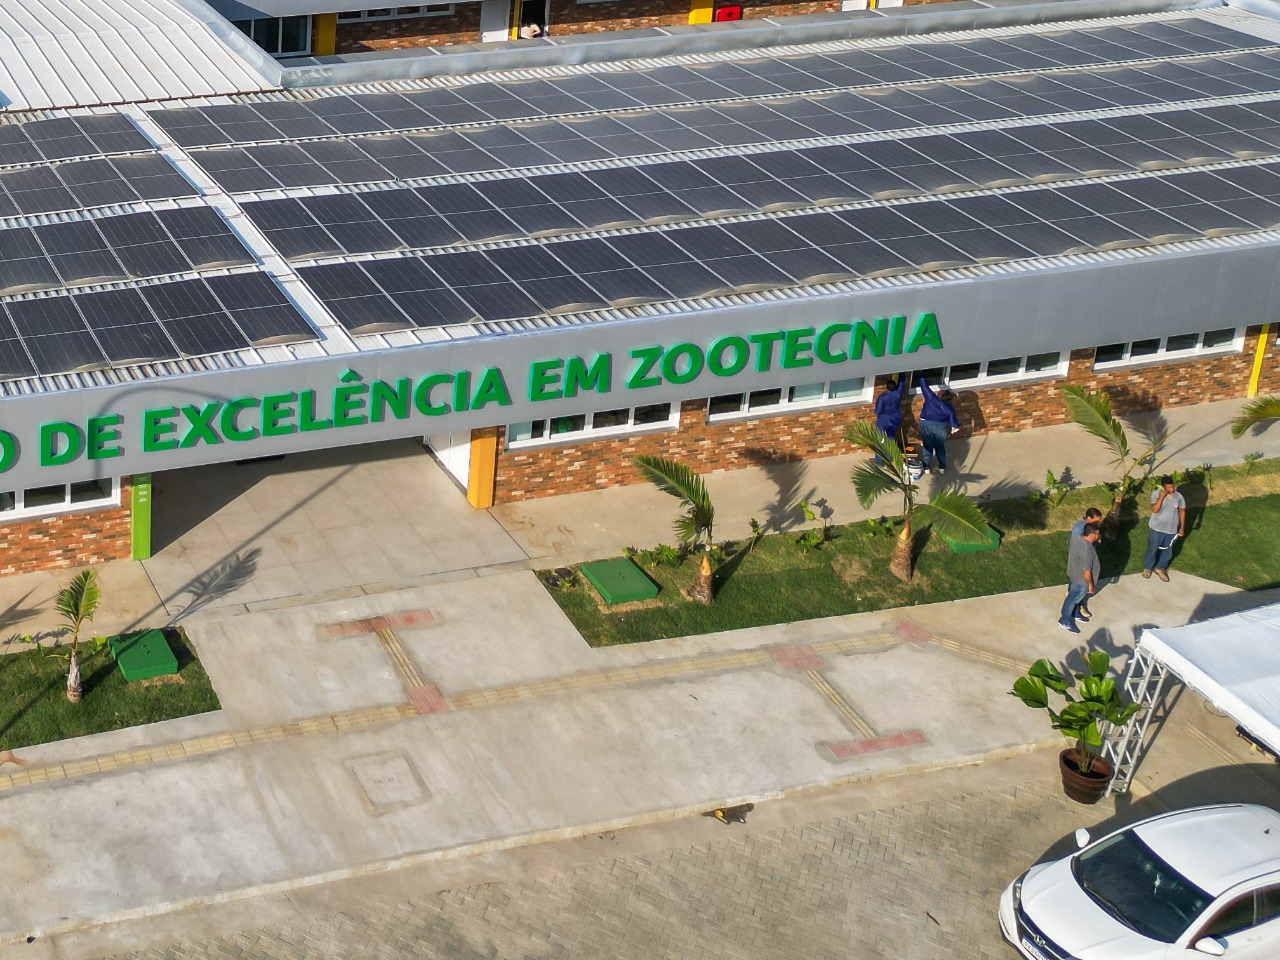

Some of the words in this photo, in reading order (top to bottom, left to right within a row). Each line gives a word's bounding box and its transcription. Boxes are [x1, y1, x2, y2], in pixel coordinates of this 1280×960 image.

[39, 414, 122, 467] DE
[142, 368, 511, 453] EXCELÊNCIA
[527, 354, 611, 403] EM
[624, 312, 943, 390] ZOOTECNIA
